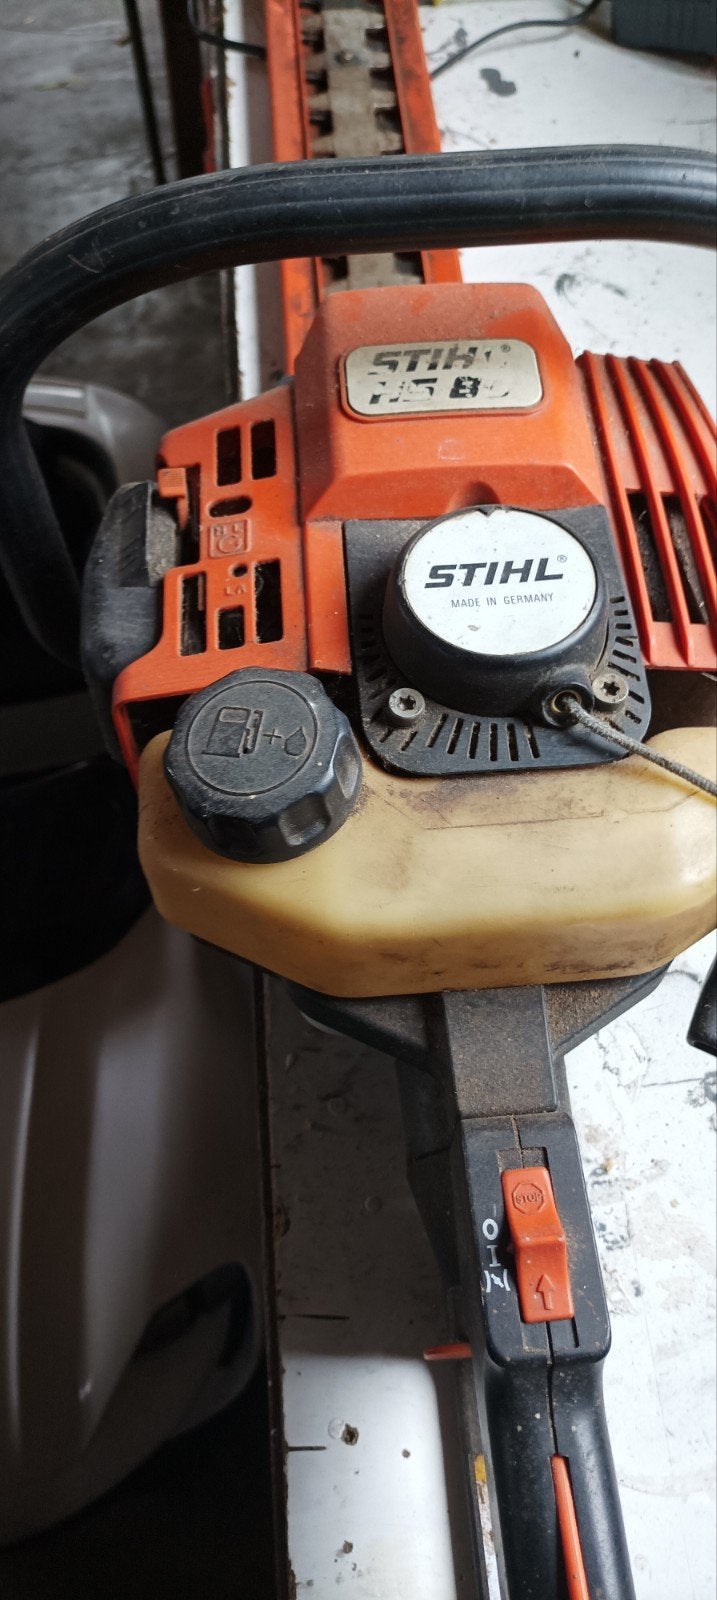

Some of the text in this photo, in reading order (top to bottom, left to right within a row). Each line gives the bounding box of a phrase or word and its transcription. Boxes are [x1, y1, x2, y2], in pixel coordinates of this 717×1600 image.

[368, 346, 507, 375] STIH
[424, 557, 564, 589] STIHL
[451, 592, 554, 608] MADE IN GERMANY
[515, 1193, 542, 1205] STOP
